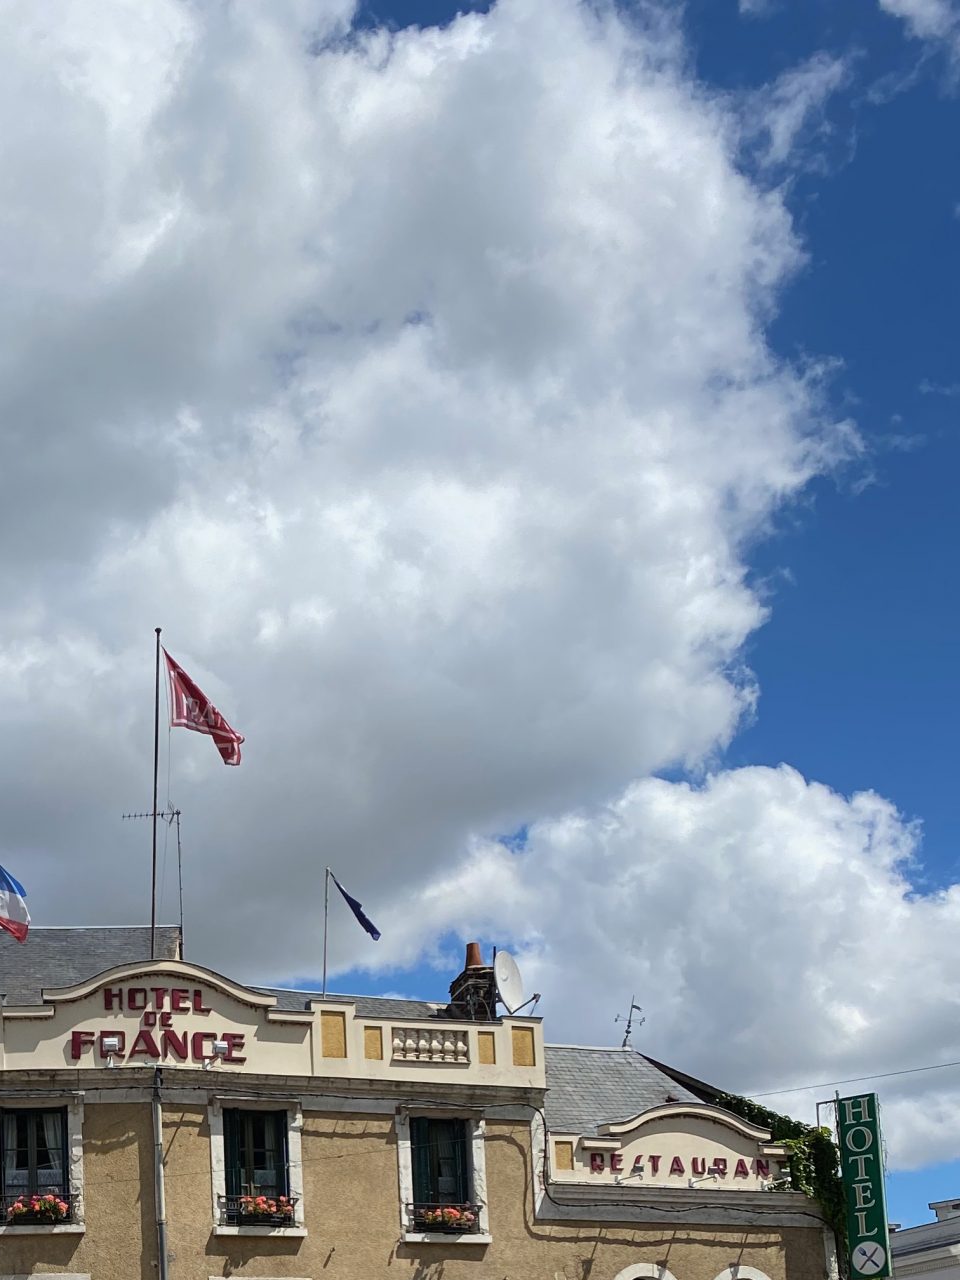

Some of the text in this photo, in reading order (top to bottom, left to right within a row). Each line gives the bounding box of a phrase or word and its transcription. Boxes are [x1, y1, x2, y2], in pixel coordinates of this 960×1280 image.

[104, 987, 212, 1012] HOTEL
[144, 1011, 173, 1027] DE
[71, 1030, 247, 1062] FRANCE
[842, 1096, 878, 1237] HOTEL
